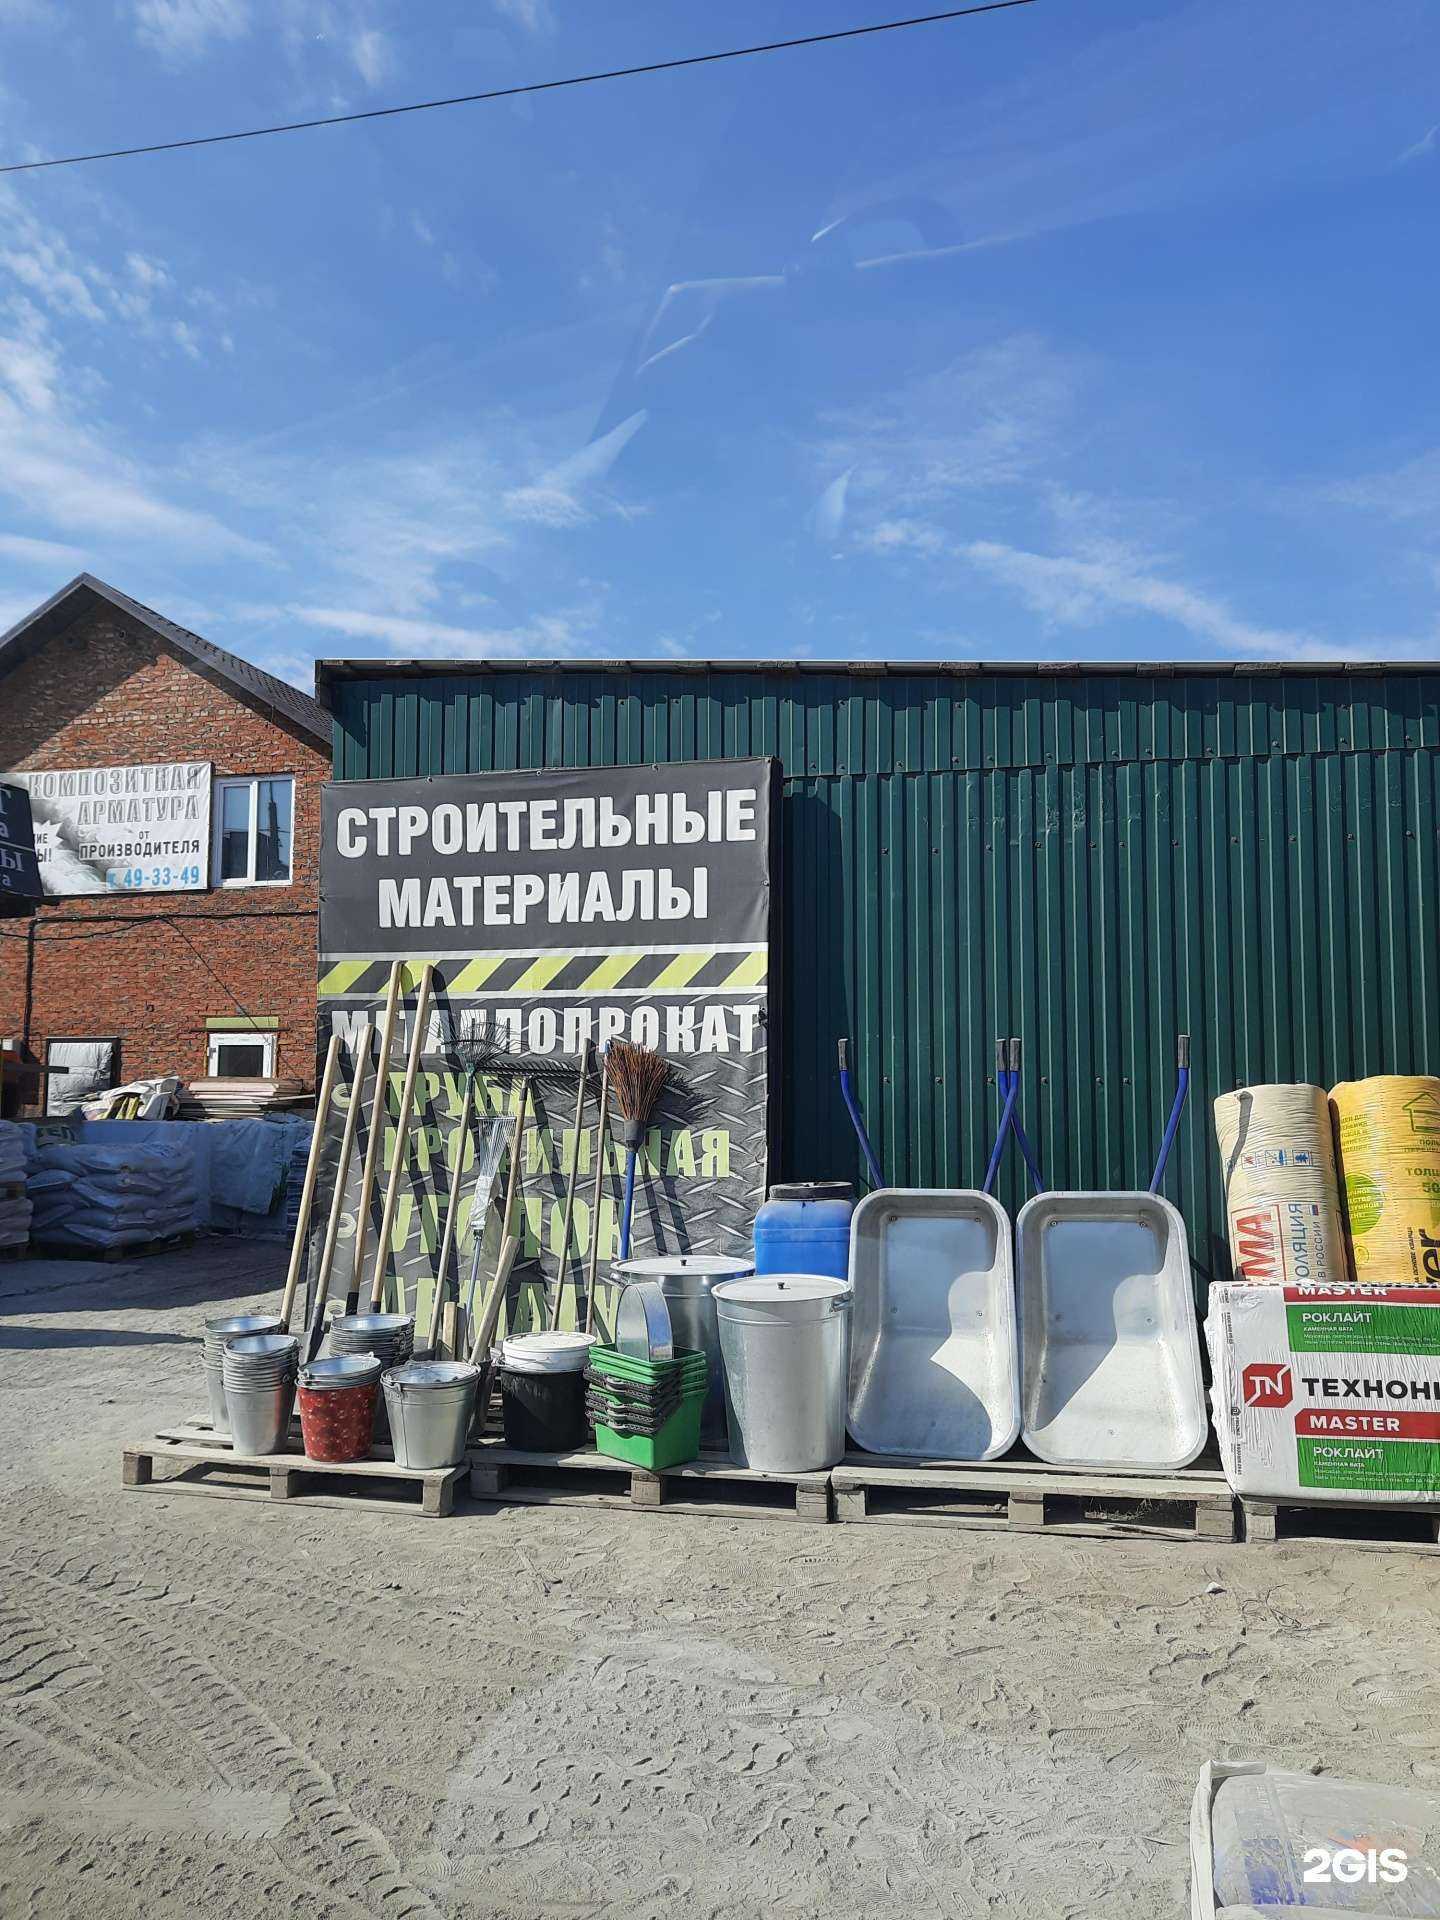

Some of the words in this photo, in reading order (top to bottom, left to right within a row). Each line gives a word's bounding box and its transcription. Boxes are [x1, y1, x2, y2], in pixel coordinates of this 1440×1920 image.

[28, 763, 201, 799] КОМПОЗИТНАЯ
[78, 795, 200, 825] АРМАТУРА
[336, 788, 757, 859] СТРОИТЕЛЬНЫЕ
[80, 840, 200, 858] ПРОИЗВОДИТЕЛЯ
[139, 831, 150, 839] ОТ
[124, 865, 200, 887] 49-33-49
[378, 867, 708, 929] МАТЕРИАЛЫ
[383, 1126, 730, 1178] ПРОИЛЬНАЯ
[1287, 1203, 1310, 1281] ОЛЯЦИЯ
[1312, 1221, 1325, 1267] РОССИИ
[1302, 1311, 1372, 1323] РОКЛАЙТ
[1310, 1415, 1400, 1432] MASTER
[1313, 1446, 1384, 1460] РОКЛАЙТ
